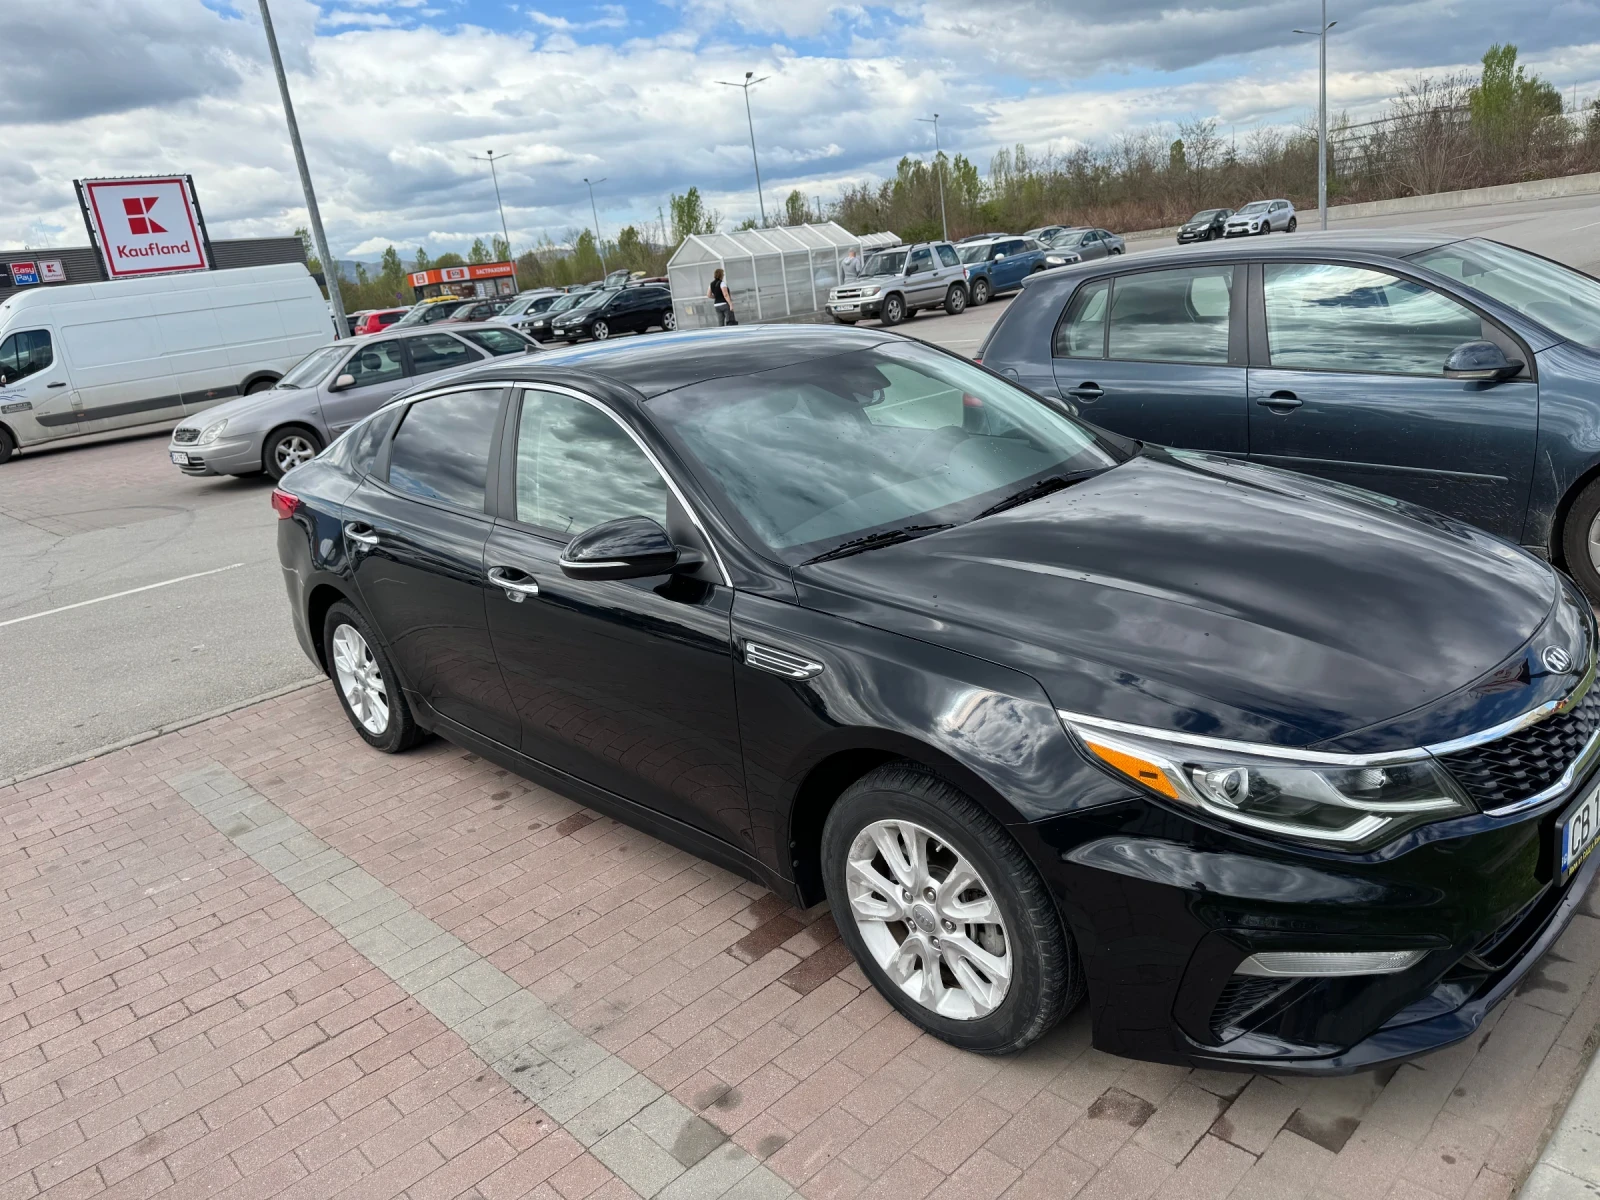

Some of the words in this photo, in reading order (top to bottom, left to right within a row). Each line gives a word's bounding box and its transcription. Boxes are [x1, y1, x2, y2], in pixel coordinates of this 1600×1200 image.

[116, 240, 191, 259] Kaufland
[13, 266, 35, 275] Easy
[475, 265, 511, 275] ЗАСТРАХОВКИ
[16, 274, 33, 282] Pay
[1571, 803, 1590, 856] CB
